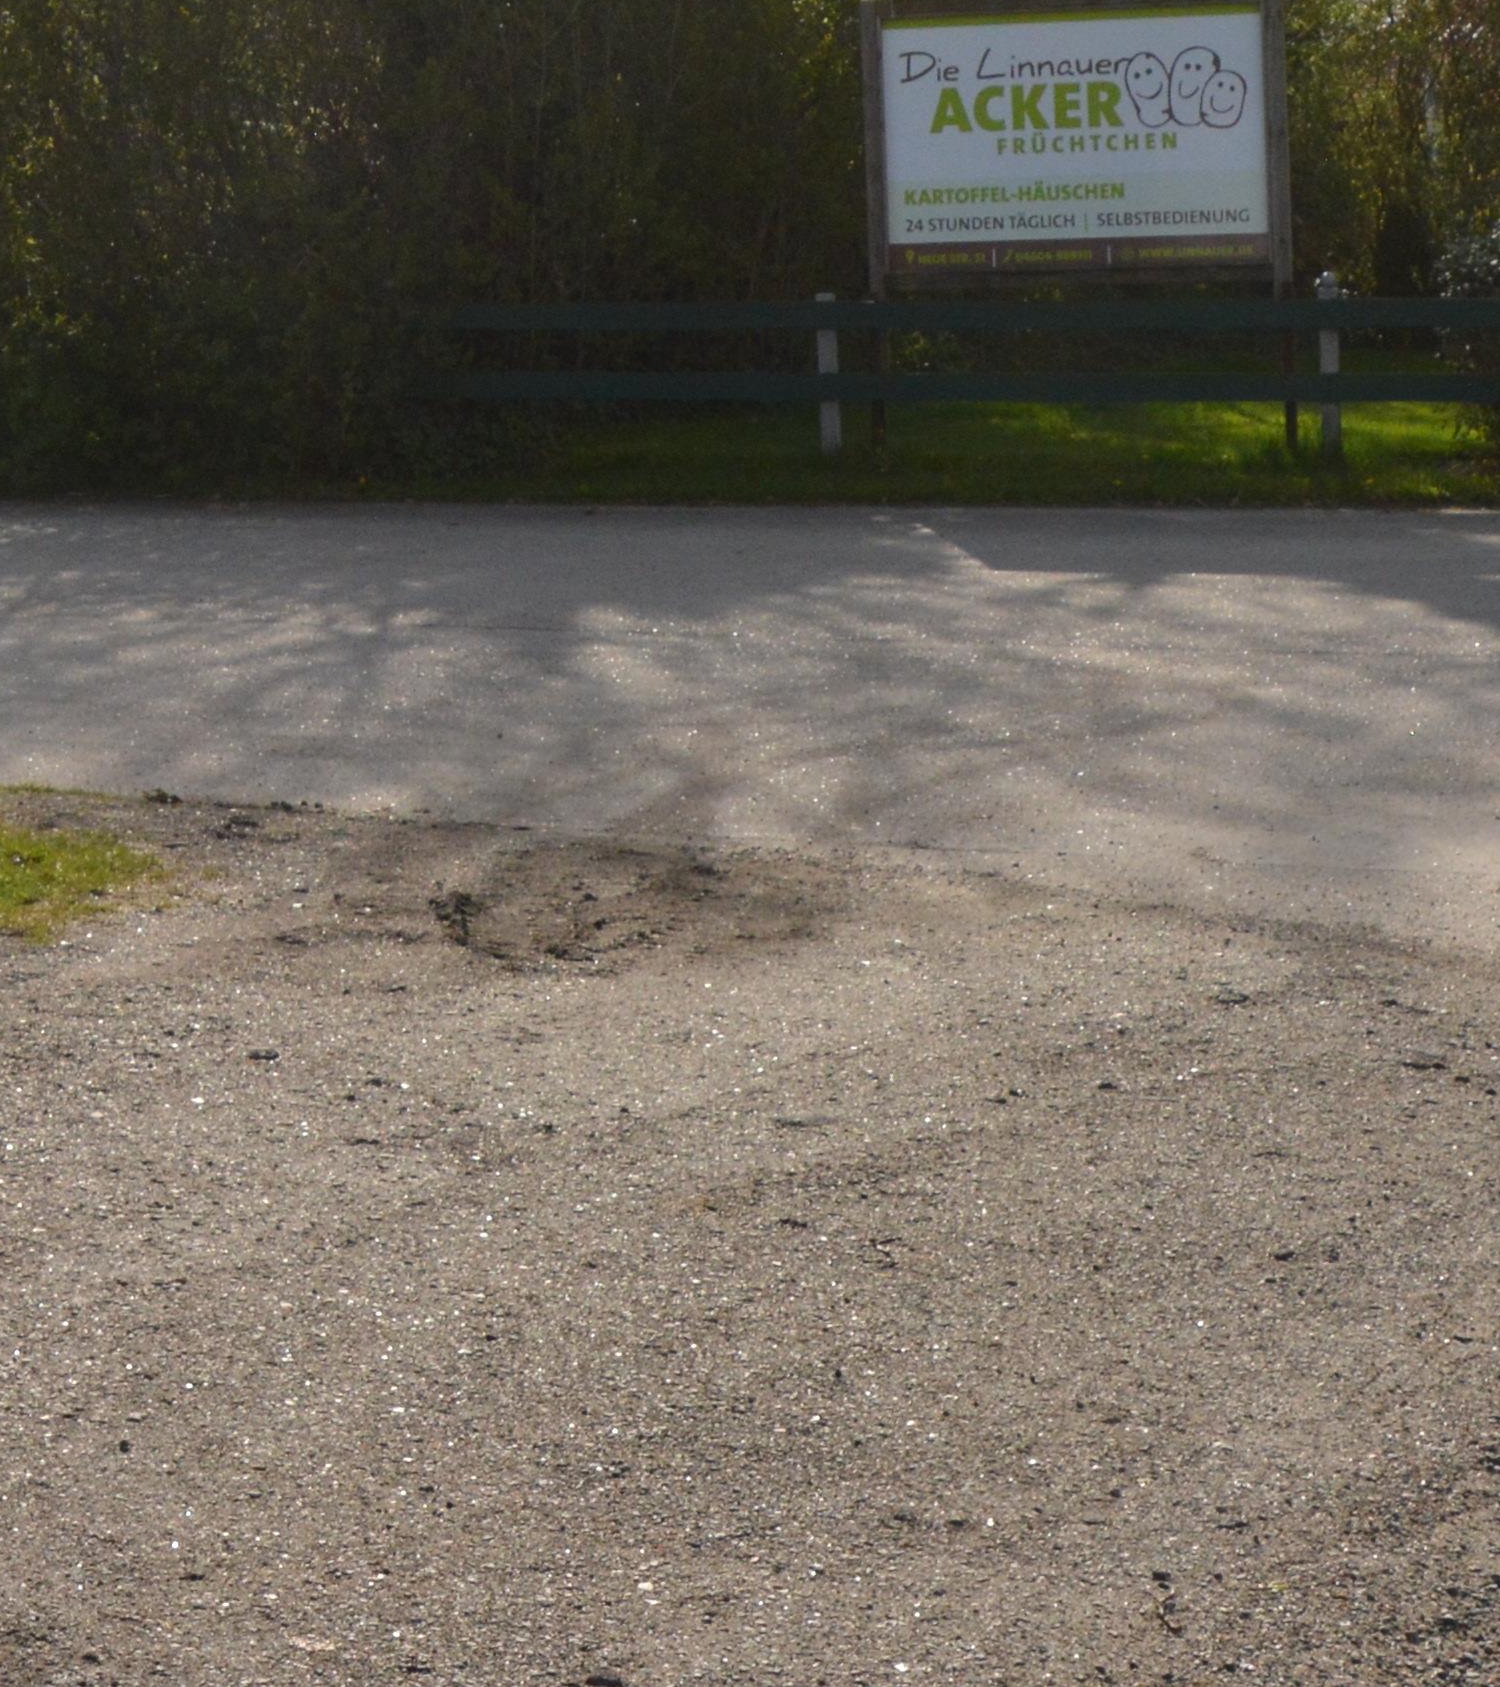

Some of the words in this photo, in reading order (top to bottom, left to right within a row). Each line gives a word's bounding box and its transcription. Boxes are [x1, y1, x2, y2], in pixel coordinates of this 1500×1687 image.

[899, 50, 960, 84] Die
[976, 47, 1130, 80] Linnauer
[930, 81, 1124, 134] ACKER
[996, 132, 1178, 155] FRÜCHTCHEN
[903, 180, 1126, 206] KARTOFFEL-HÄUSCHEN
[906, 218, 924, 233] 24
[928, 215, 1004, 232] STUNDEN
[1009, 211, 1075, 230] TÄGLICH
[1096, 208, 1250, 227] SELBSTBEDIENUNG
